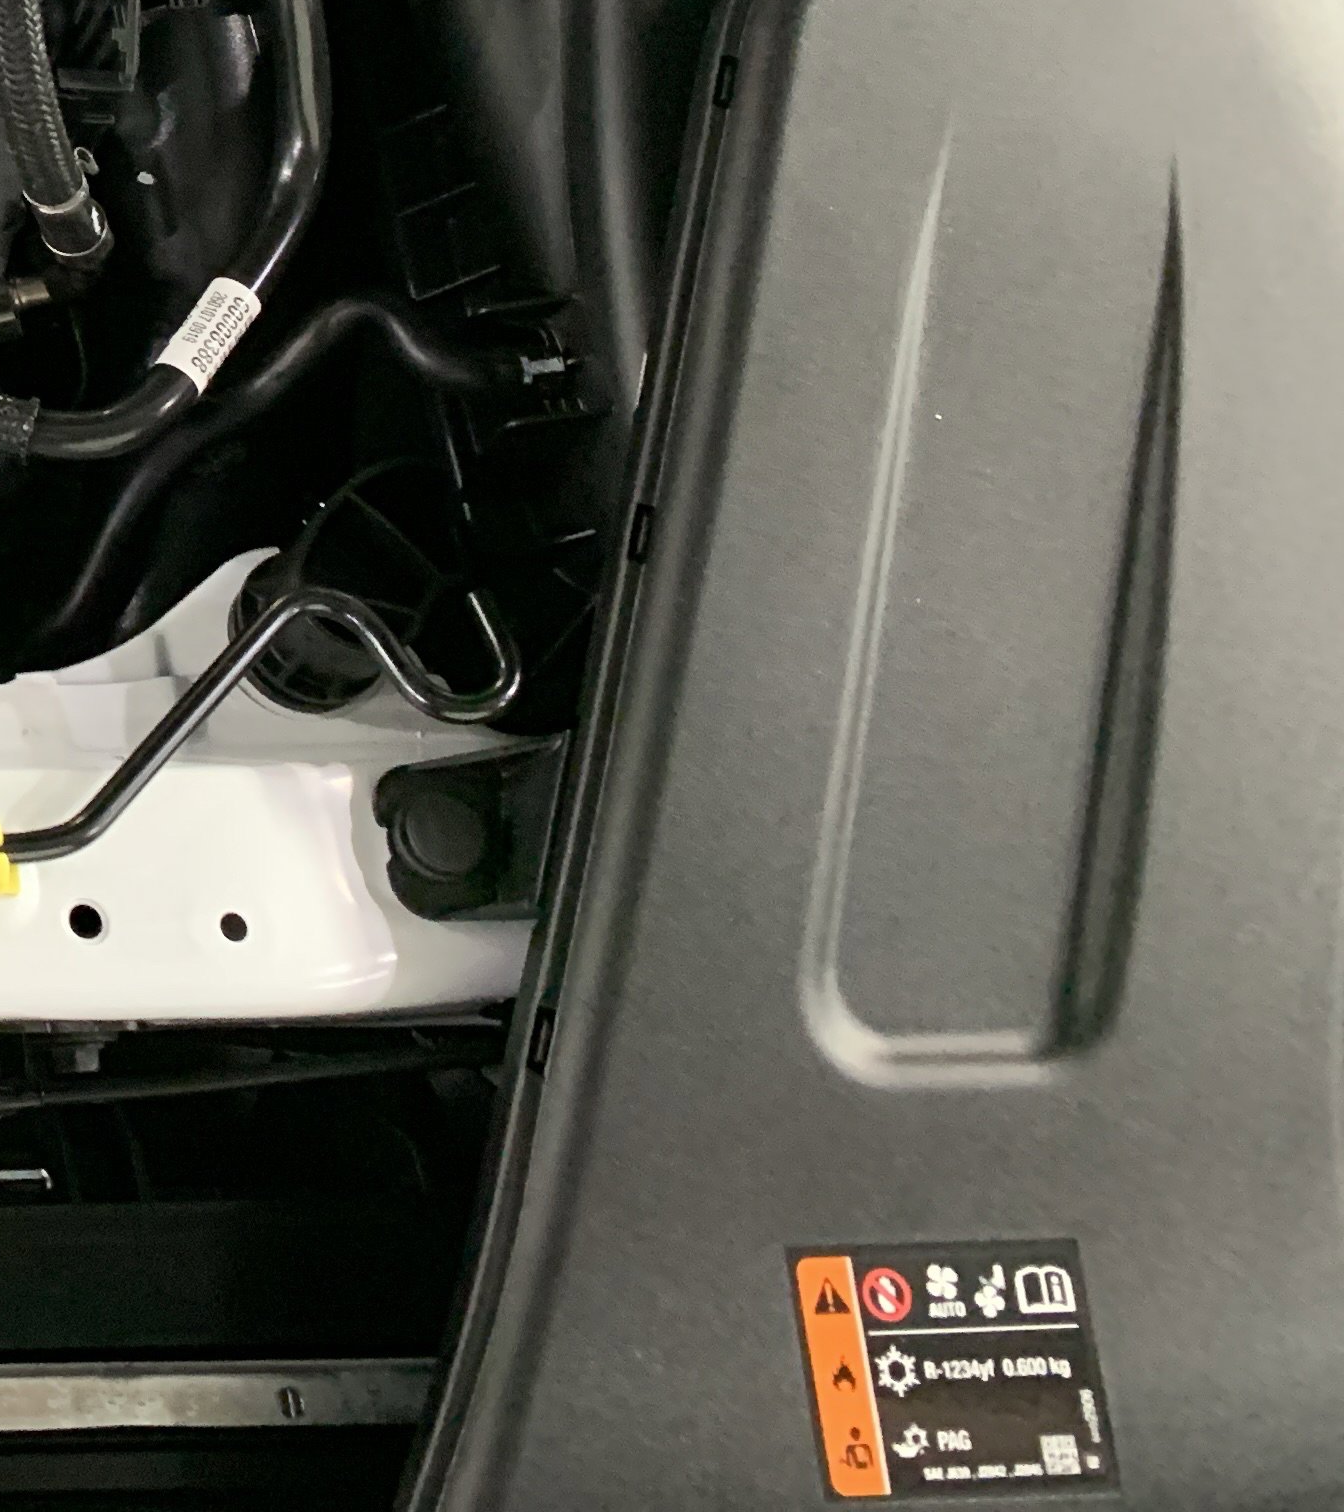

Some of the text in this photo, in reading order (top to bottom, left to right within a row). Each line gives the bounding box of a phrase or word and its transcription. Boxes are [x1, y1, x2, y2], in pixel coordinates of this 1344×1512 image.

[928, 1301, 967, 1319] AUTO
[1048, 1356, 1072, 1379] kg
[936, 1430, 973, 1452] PAG
